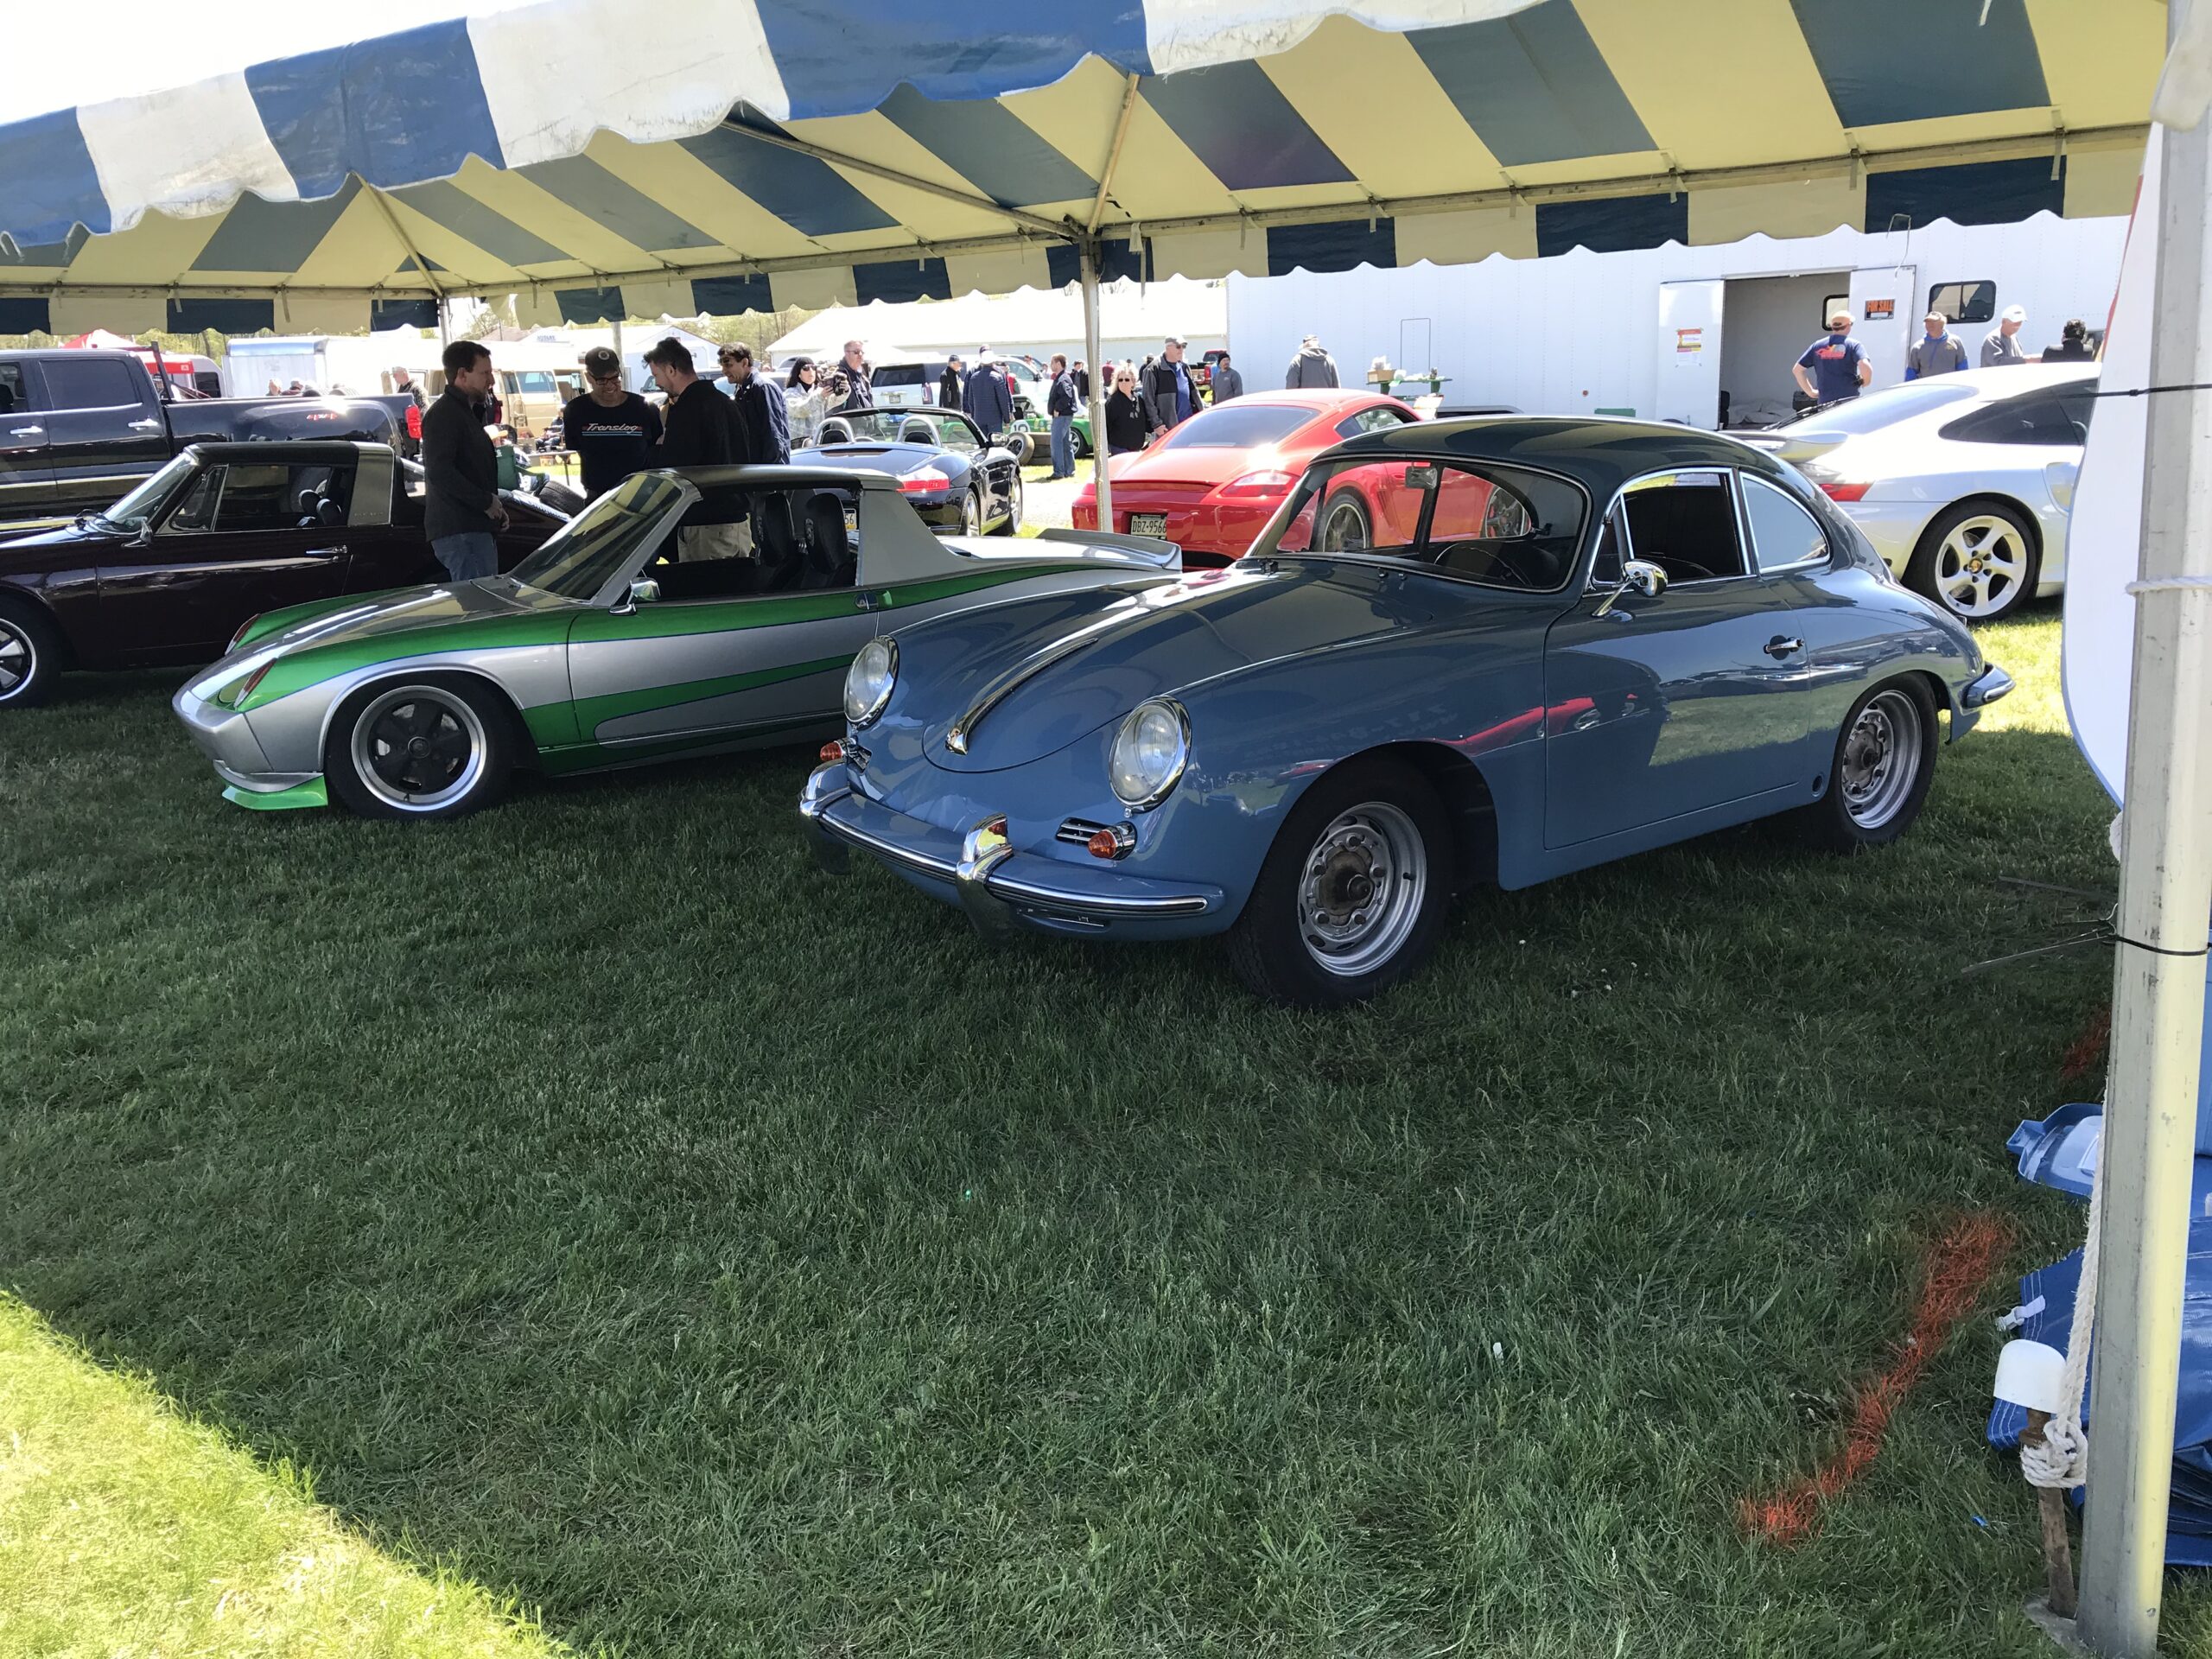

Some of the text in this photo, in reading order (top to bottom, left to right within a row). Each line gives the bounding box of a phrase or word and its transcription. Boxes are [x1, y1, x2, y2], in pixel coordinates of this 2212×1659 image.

[1867, 299, 1895, 312] FOR SALE
[587, 423, 639, 434] Translog
